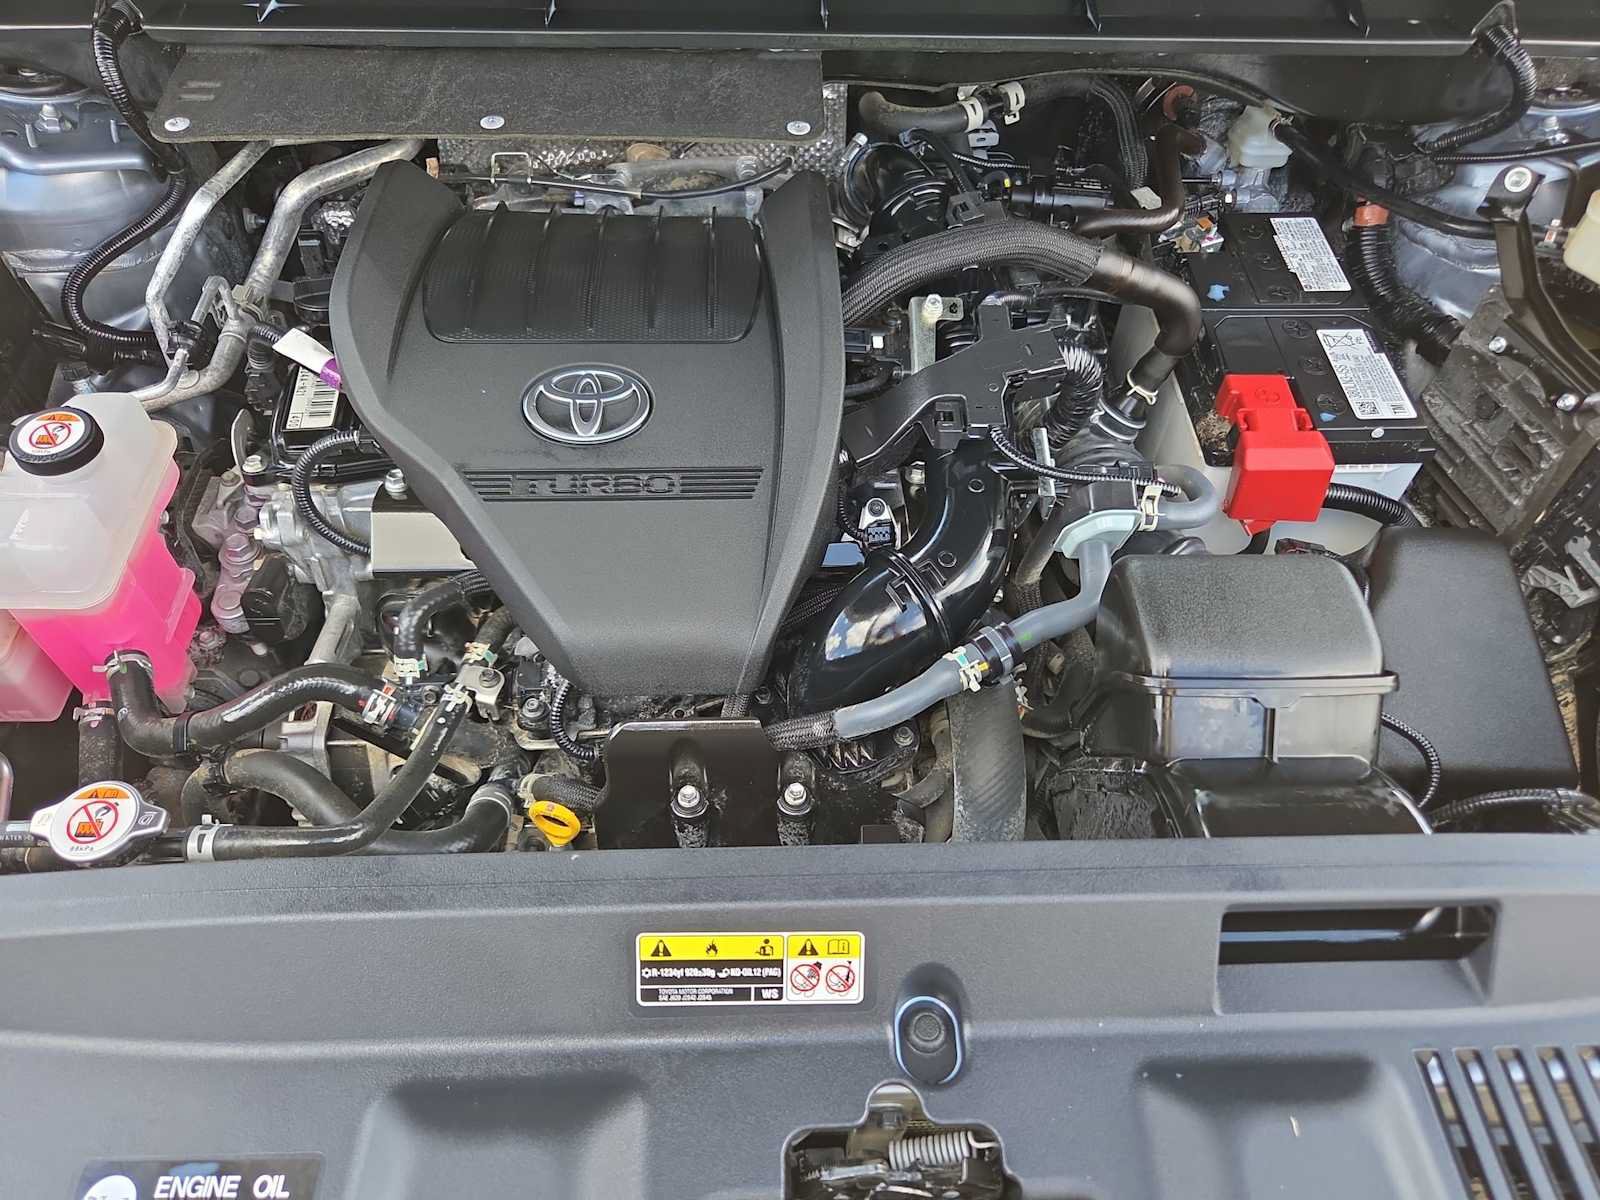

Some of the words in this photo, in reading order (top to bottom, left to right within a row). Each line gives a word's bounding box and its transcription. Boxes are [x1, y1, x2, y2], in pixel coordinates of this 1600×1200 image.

[516, 473, 674, 495] TURBO
[761, 988, 779, 999] WS
[153, 1175, 242, 1199] ENGINE
[252, 1174, 290, 1199] OIL
